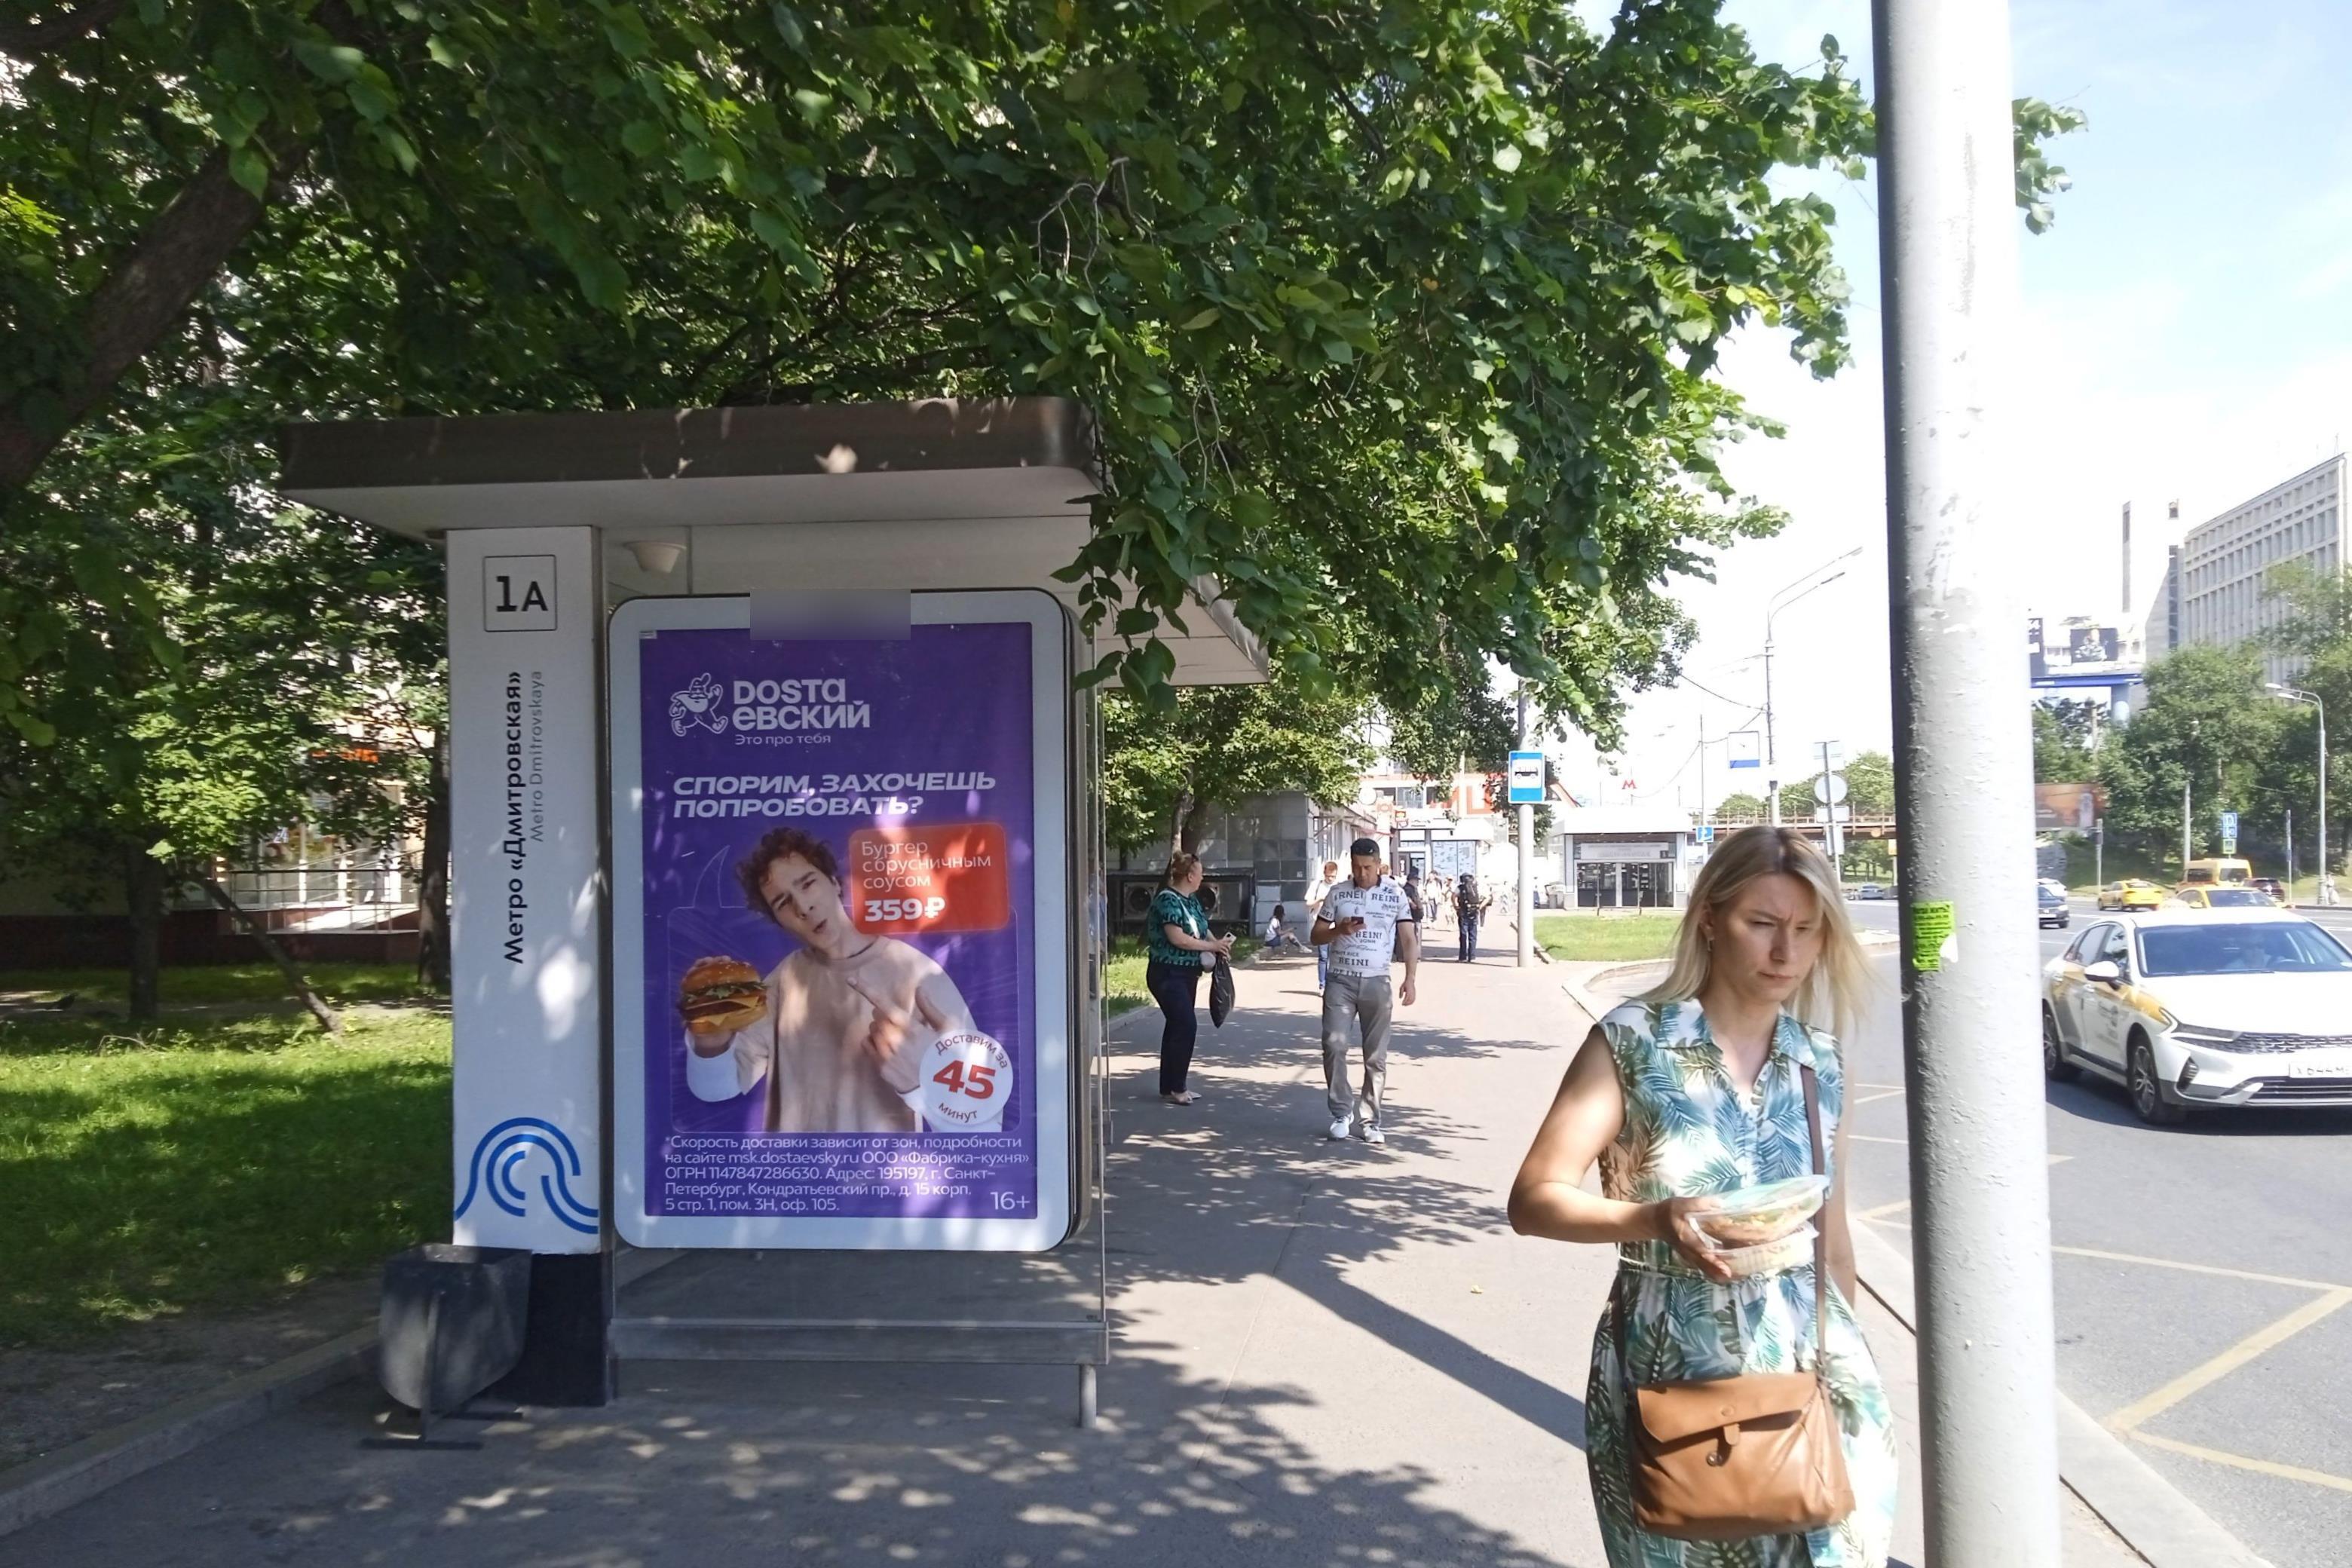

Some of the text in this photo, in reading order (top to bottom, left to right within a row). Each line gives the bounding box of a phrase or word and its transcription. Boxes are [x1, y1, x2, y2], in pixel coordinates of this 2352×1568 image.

[734, 733, 831, 746] Это про тебя
[528, 670, 545, 843] Metro Dmitrovskaya
[673, 771, 996, 796] СПОРИМ, ЗАХОЧЕШЬ
[673, 795, 924, 818] ПОПРОБОВАТЬ?
[504, 671, 528, 964] Метро «Дмитровская»
[862, 841, 928, 859] Бургер
[862, 856, 991, 876] с брусничным
[863, 875, 931, 893] соусом
[935, 1034, 1008, 1069] Доставим за
[933, 1059, 997, 1100] 45
[938, 1102, 978, 1123] минут
[740, 1138, 808, 1150] доставки
[810, 1138, 869, 1148] зависит
[871, 1138, 889, 1148] от
[891, 1138, 921, 1150] зон,
[923, 1135, 1021, 1150] подробности
[665, 1154, 681, 1164] на
[684, 1152, 726, 1164] сайте
[728, 1151, 859, 1166] msk.dostaevsky.ru
[862, 1151, 898, 1164] ООО
[665, 1167, 996, 1182] ОГРН 1147847286630. Адрес: 195197, г. Санкт-
[665, 1182, 972, 1197] Петербург, Кондратьевский пр., д. 15 корп.
[666, 1198, 675, 1211] 5
[678, 1201, 705, 1213] стр.
[708, 1198, 717, 1211] 1,
[720, 1200, 752, 1211] пом.
[781, 1198, 809, 1213] оф.
[812, 1198, 840, 1211] 105.
[989, 1191, 1031, 1211] 16+
